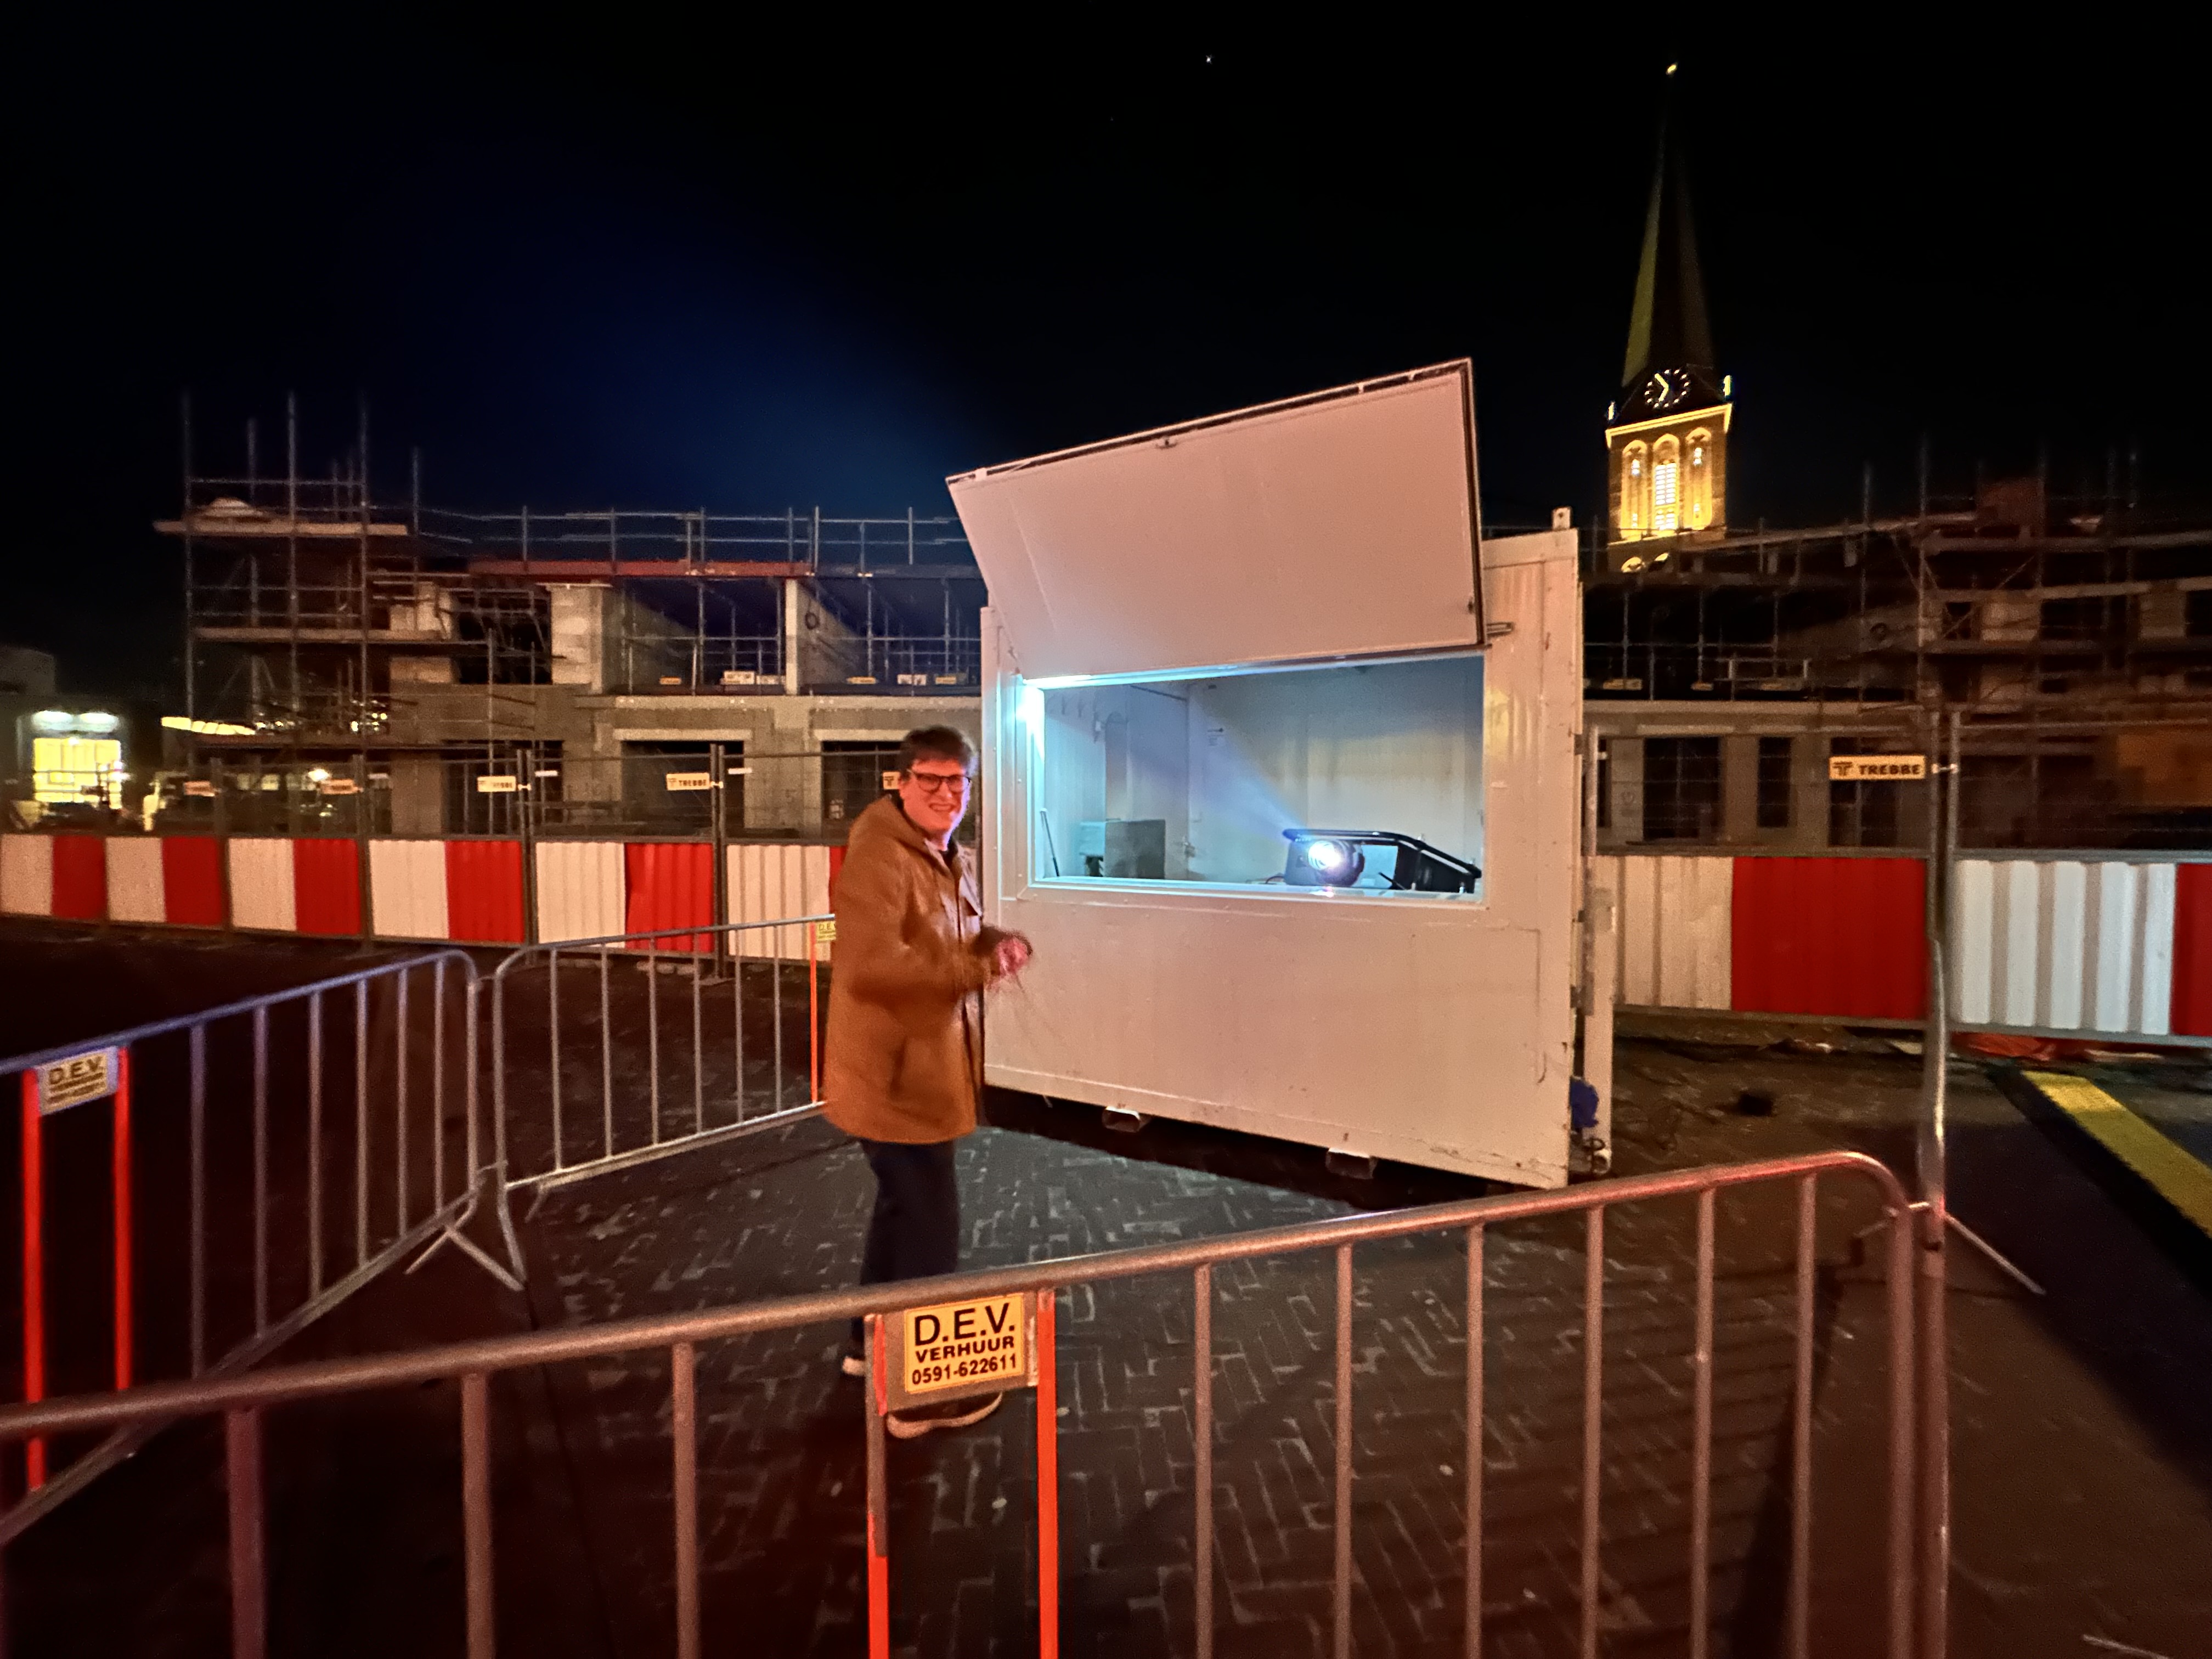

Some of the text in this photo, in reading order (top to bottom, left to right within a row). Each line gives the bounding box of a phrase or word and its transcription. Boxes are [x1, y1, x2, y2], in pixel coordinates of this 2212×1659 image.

[1859, 764, 1921, 775] TREBBE
[915, 1302, 1015, 1346] D.E.V.
[916, 1335, 1014, 1363] VERHUUR
[912, 1354, 1016, 1385] 0591-622611
